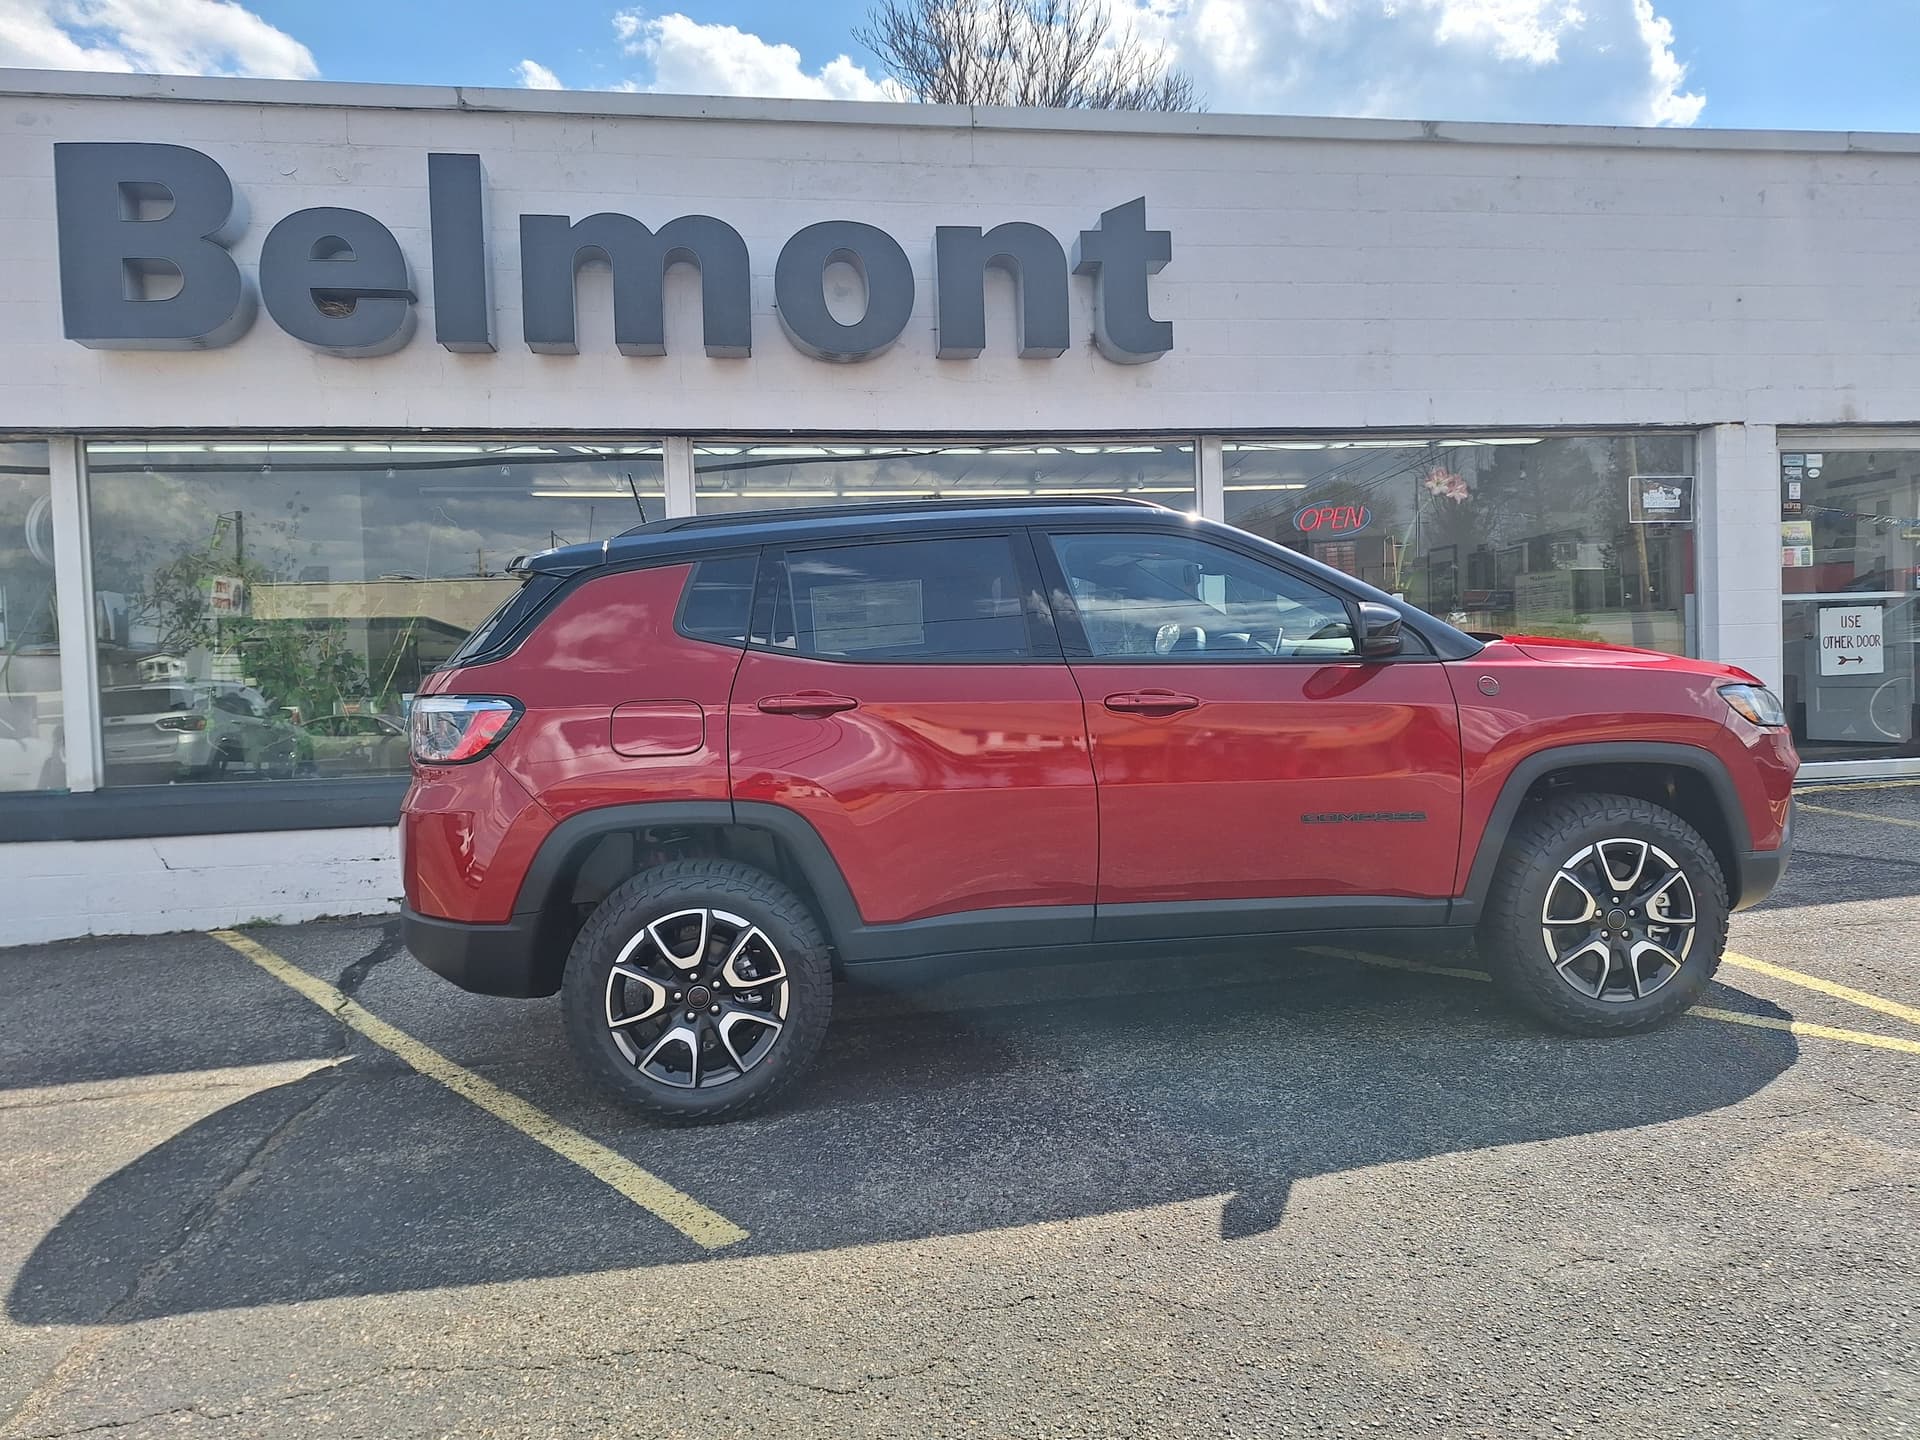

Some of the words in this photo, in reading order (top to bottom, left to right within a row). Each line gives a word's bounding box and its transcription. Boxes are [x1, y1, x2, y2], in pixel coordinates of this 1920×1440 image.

[54, 142, 1173, 364] Belmont
[1300, 506, 1364, 531] OPEN
[1840, 615, 1861, 628] USE
[1823, 635, 1854, 649] OTHER
[1856, 634, 1881, 648] DOOR
[1301, 811, 1427, 823] COMPASS
